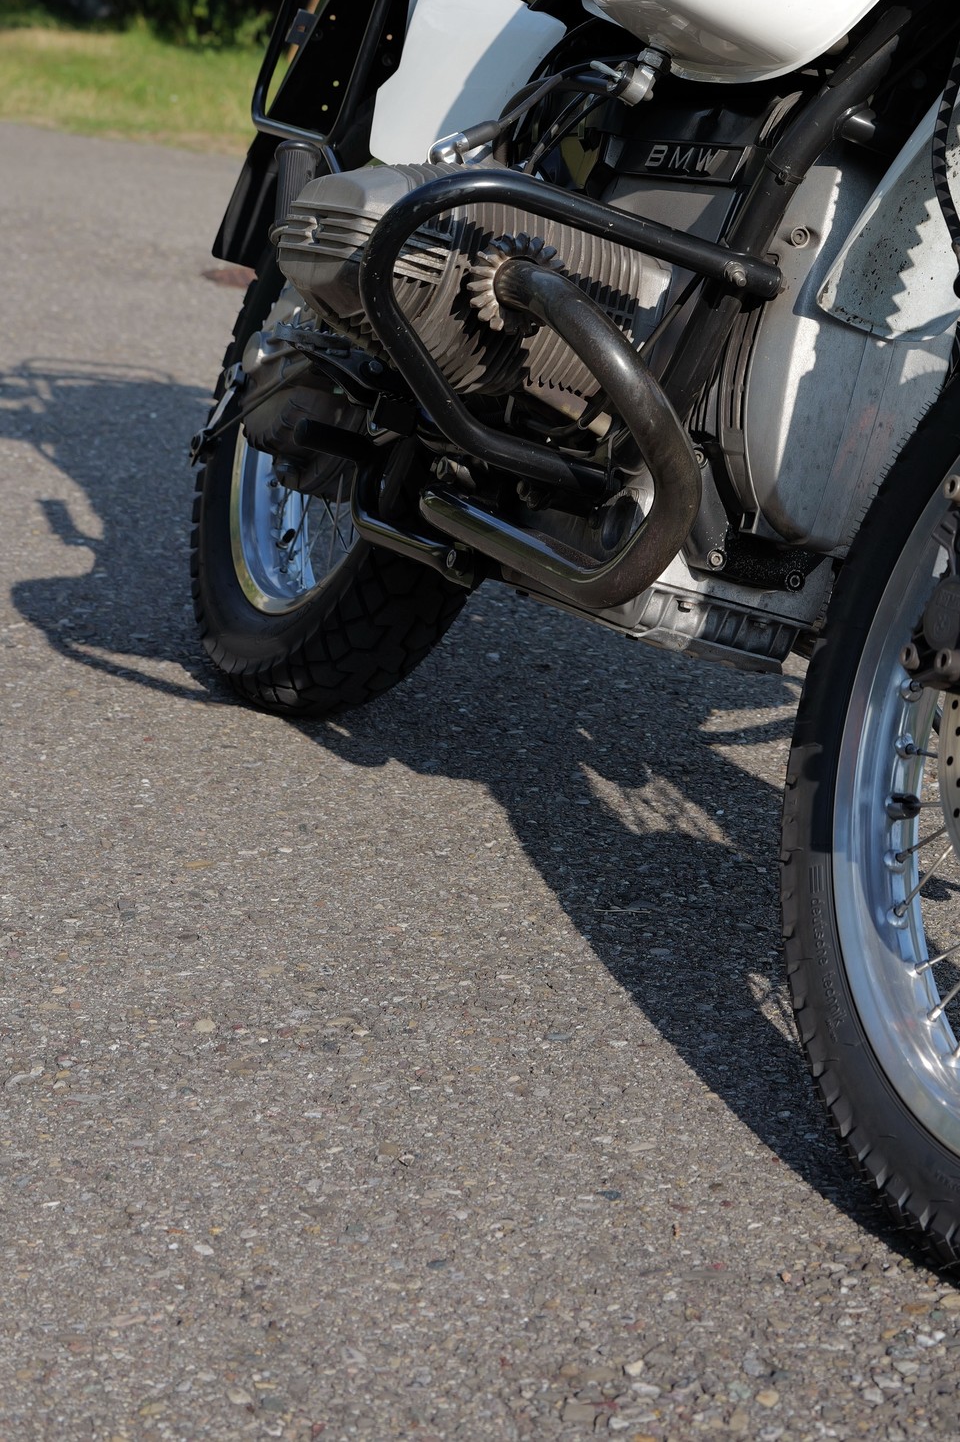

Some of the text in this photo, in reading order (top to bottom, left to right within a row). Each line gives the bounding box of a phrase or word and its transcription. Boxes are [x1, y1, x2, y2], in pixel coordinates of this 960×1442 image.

[645, 145, 729, 172] BMW
[811, 898, 830, 967] deutsche
[821, 970, 847, 1027] technik
